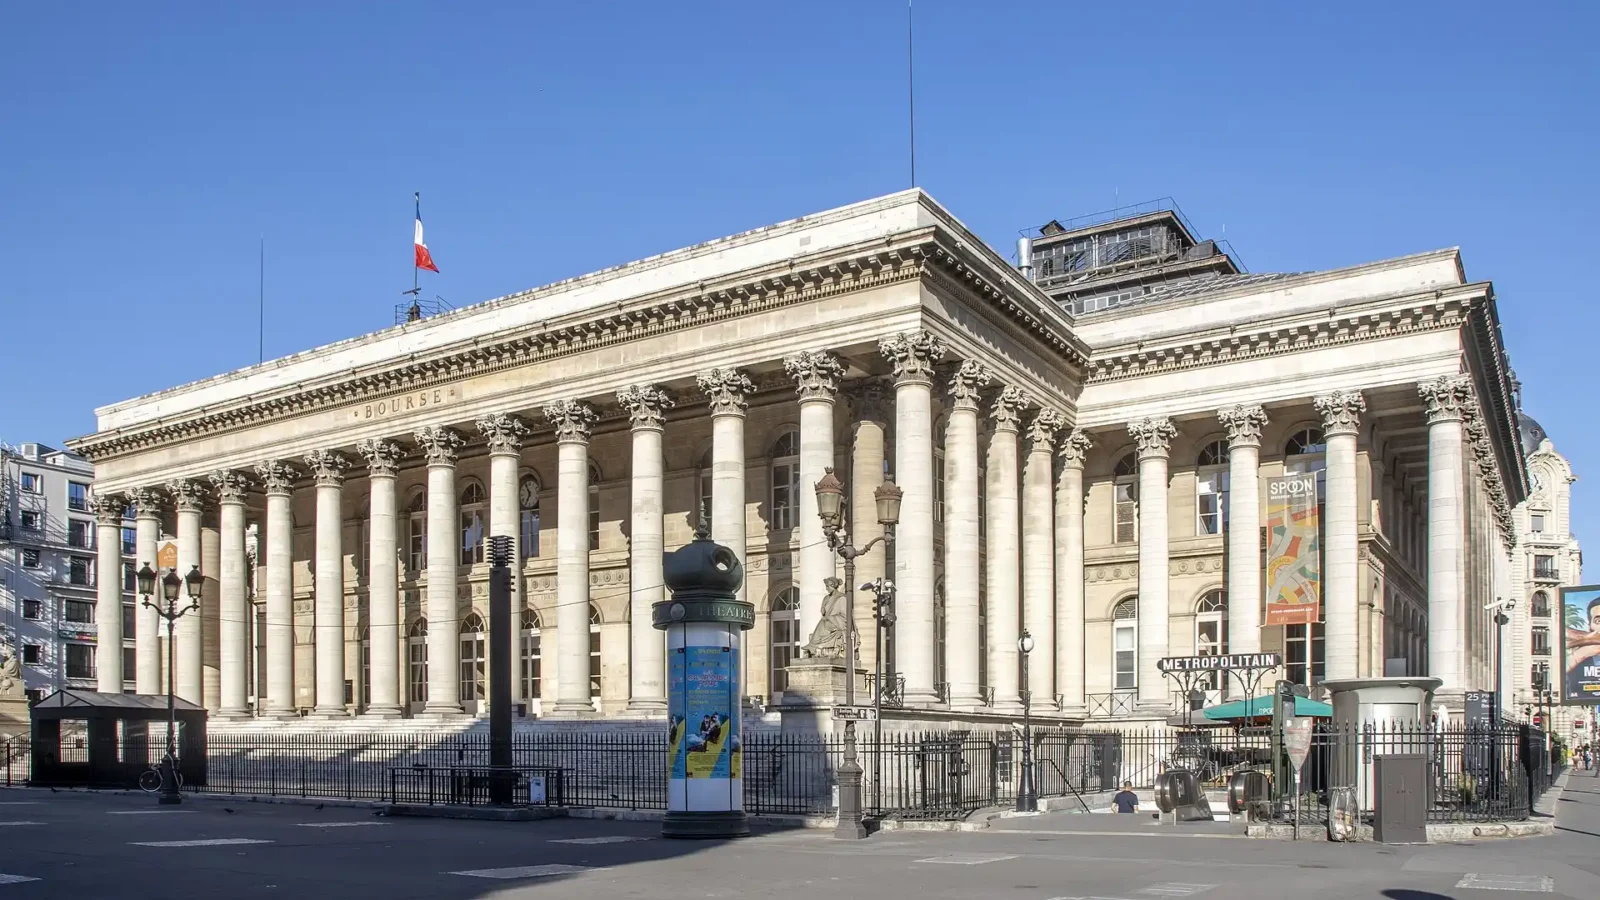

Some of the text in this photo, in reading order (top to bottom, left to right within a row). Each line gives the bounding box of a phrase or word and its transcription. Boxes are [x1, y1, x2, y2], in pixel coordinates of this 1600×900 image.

[365, 389, 441, 418] BOURSE
[1270, 478, 1313, 495] SPOON
[1163, 654, 1274, 670] METROPOLITAIN
[1466, 693, 1479, 701] 25
